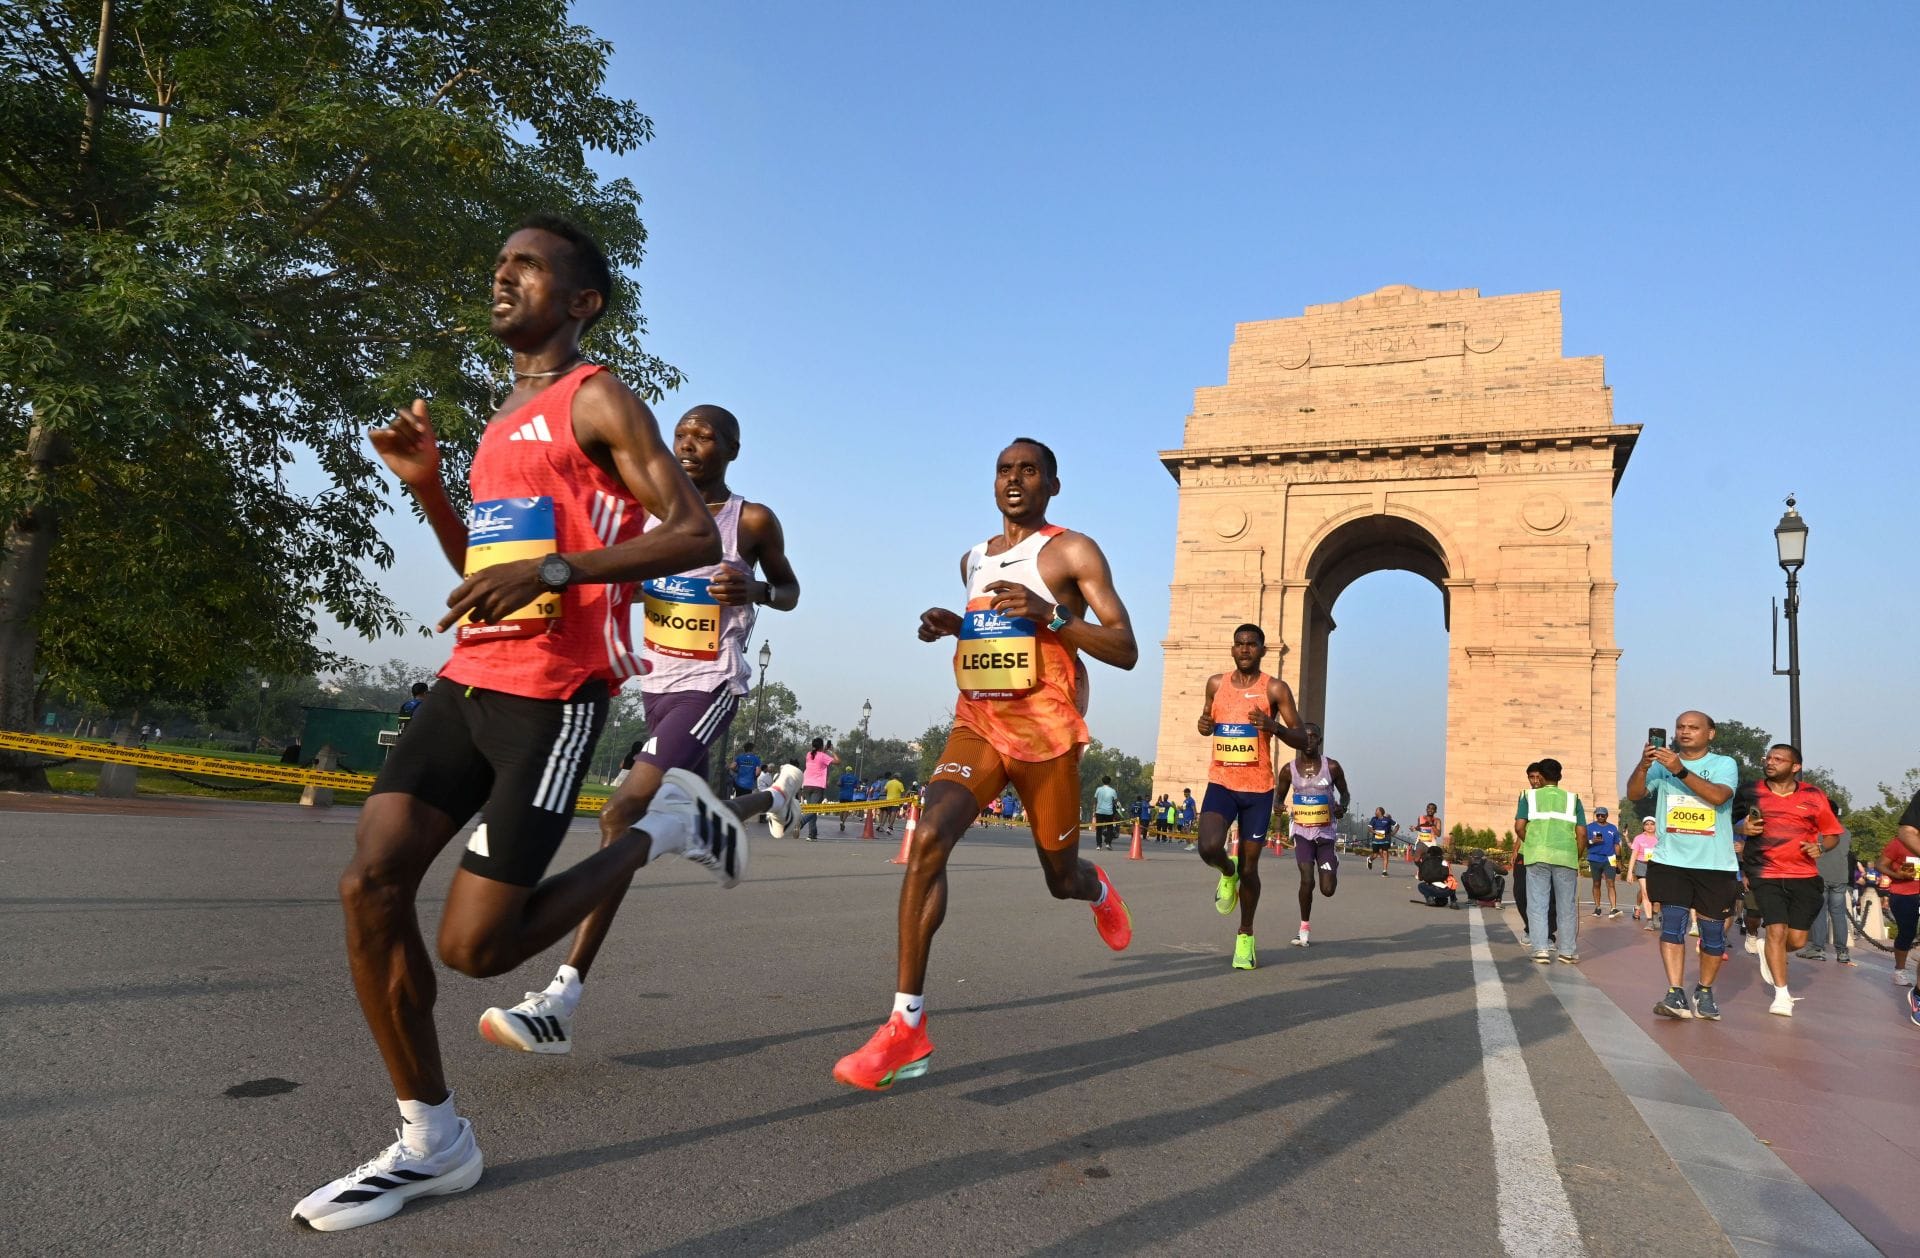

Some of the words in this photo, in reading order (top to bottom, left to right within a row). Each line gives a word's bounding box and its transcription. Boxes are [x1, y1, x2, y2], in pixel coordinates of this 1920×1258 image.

[1353, 336, 1417, 354] INDIA
[536, 603, 554, 615] 10
[708, 642, 714, 650] 6
[962, 652, 1029, 670] LEGESE
[1216, 743, 1255, 753] DIBABA
[1672, 811, 1705, 822] 20064
